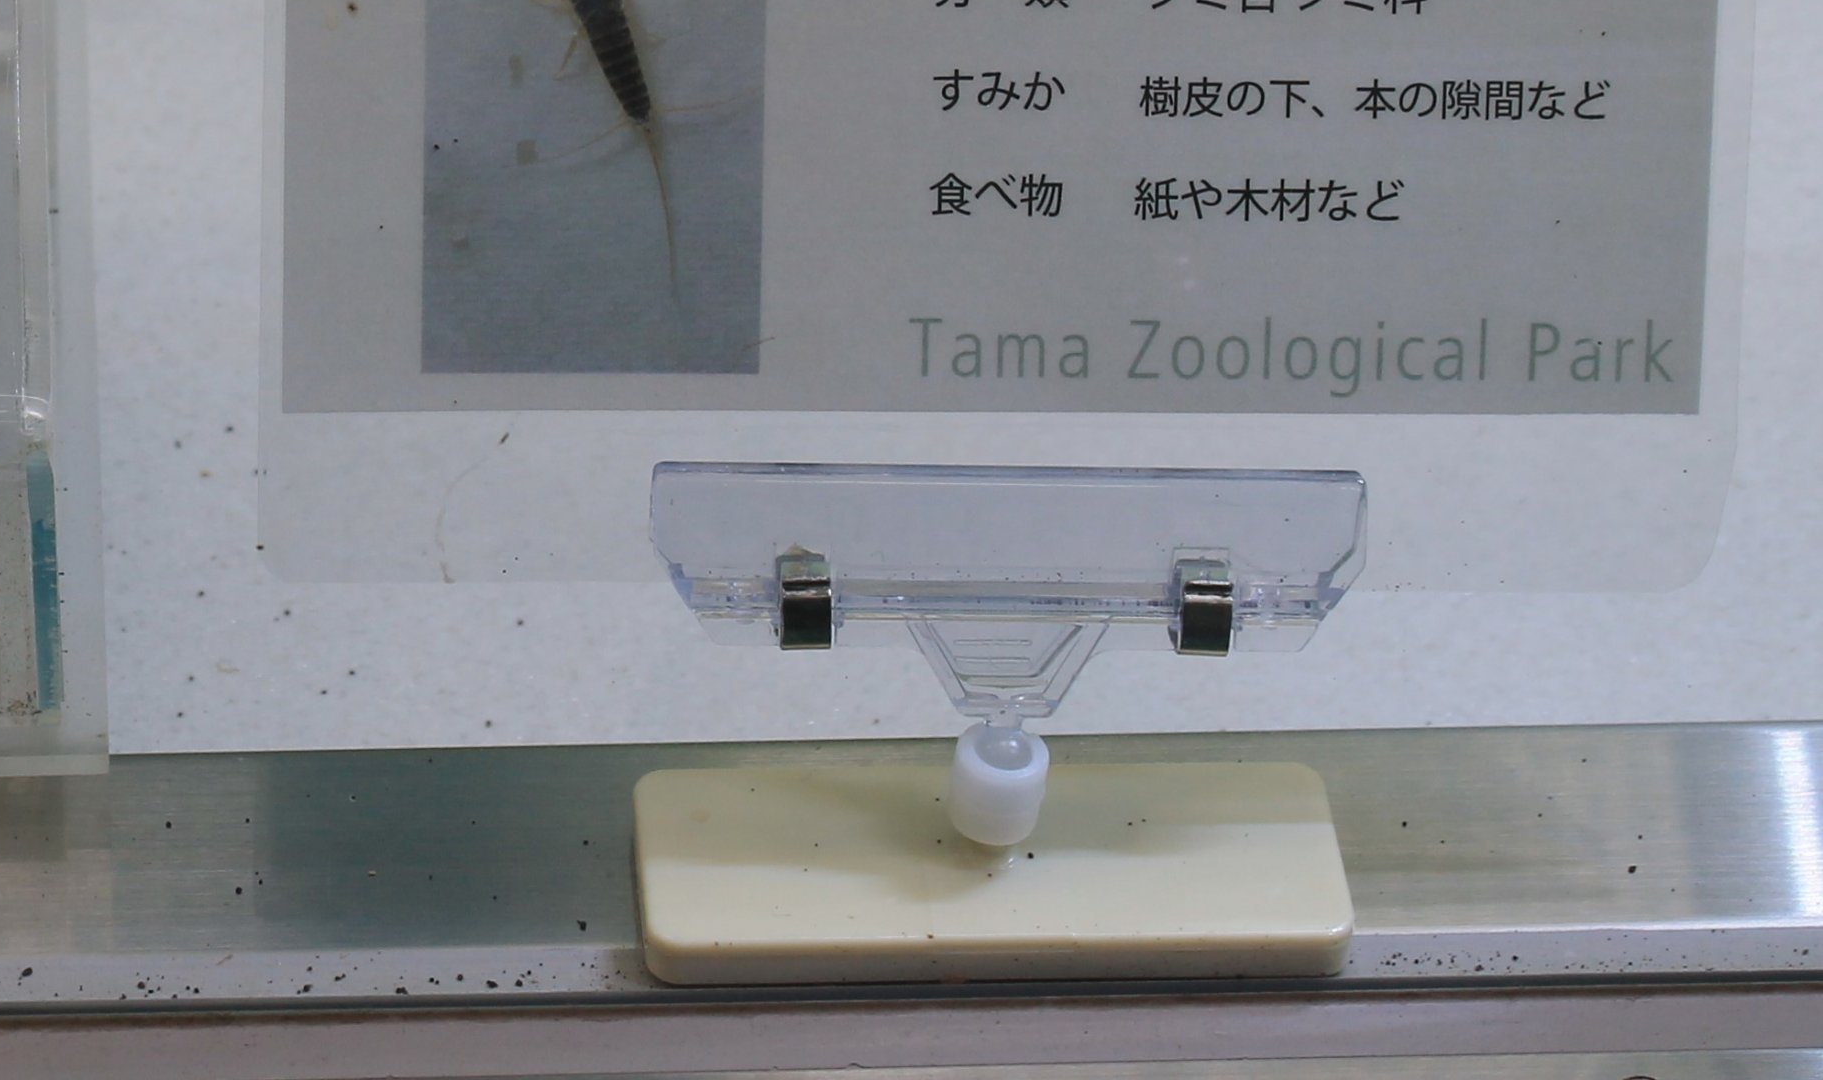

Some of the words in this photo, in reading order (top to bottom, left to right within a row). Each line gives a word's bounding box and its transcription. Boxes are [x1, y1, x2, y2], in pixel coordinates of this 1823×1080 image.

[932, 68, 1066, 112] すみか
[929, 172, 1064, 218] 食べ物
[1133, 177, 1405, 223] 紙や木材など
[909, 317, 1089, 378] Tama
[1128, 318, 1487, 398] Zoological
[1528, 319, 1673, 382] Park
